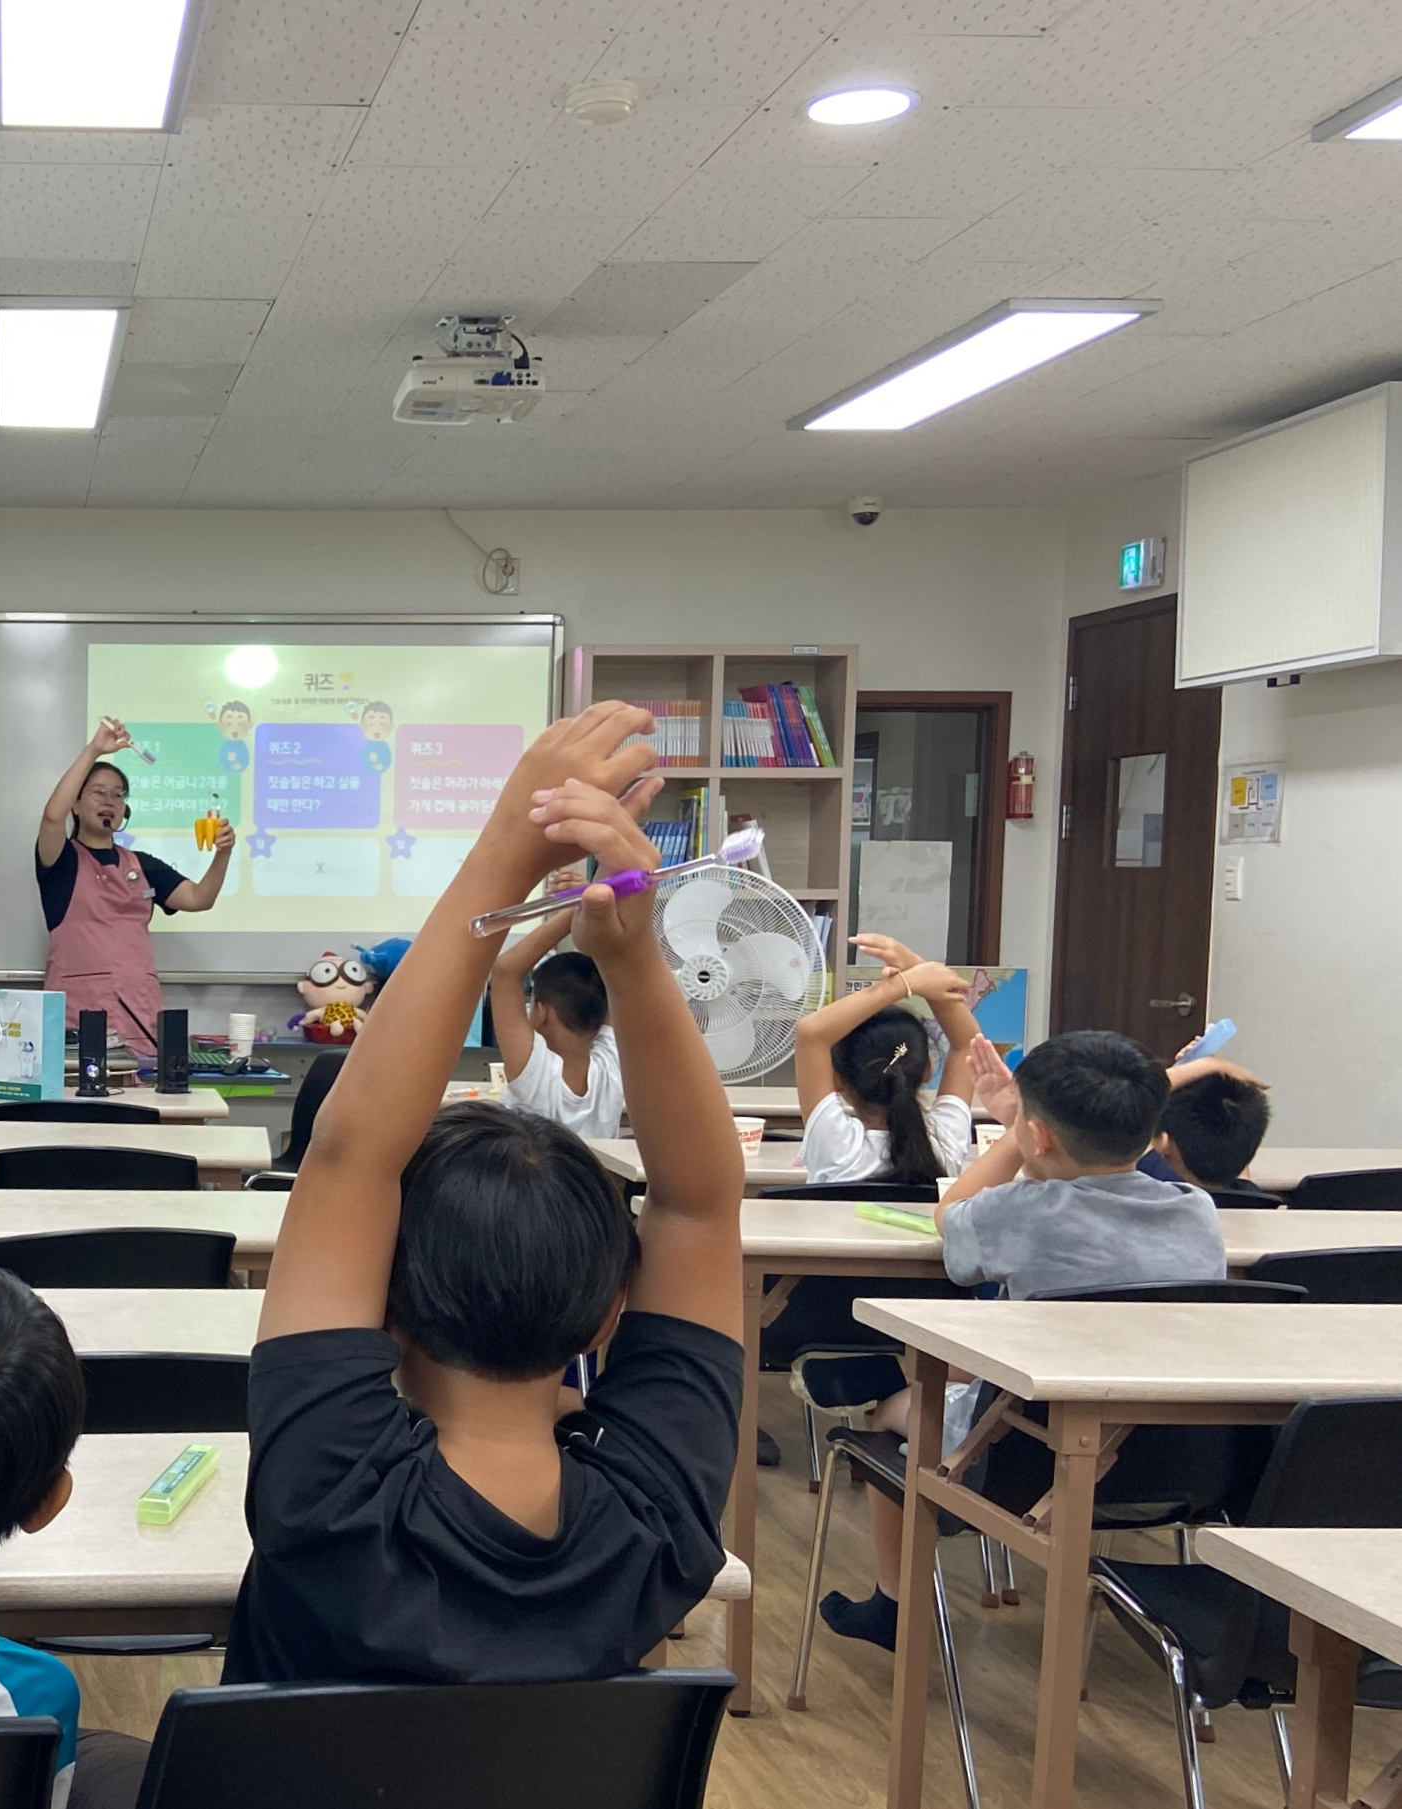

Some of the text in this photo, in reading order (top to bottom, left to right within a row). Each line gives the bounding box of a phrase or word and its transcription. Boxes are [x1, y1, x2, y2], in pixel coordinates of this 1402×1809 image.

[304, 673, 334, 691] 퀴즈
[268, 741, 301, 755] 퀴즈 2
[411, 742, 443, 755] 퀴즈 3
[314, 776, 335, 789] 하고
[444, 776, 478, 790] 머리가
[480, 776, 507, 790] 아래
[291, 799, 320, 812] 한다?
[316, 863, 324, 873] X
